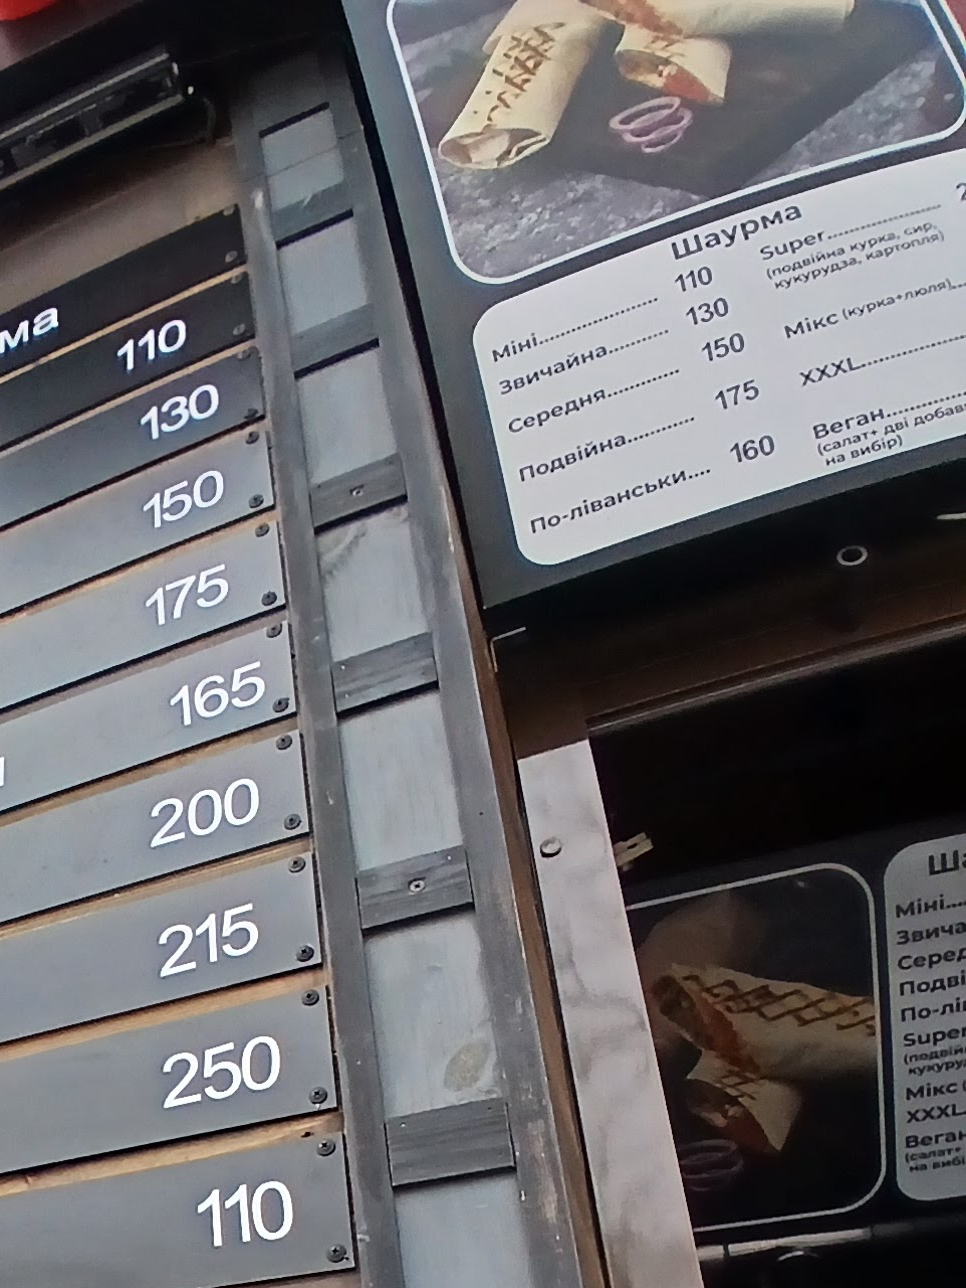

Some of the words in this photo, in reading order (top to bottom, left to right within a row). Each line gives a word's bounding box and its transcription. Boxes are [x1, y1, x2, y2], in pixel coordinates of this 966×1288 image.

[670, 204, 803, 260] Шаурма
[760, 230, 825, 261] Super
[766, 247, 845, 280] (подвійна
[850, 231, 900, 253] курка,
[774, 257, 862, 289] кукурудза,
[866, 230, 945, 261] картопля)
[492, 333, 539, 363] Міні
[674, 266, 713, 293] 110
[784, 313, 839, 339] Мікс
[116, 320, 187, 372] 110
[499, 345, 608, 395] Звичайна
[685, 297, 729, 326] 130
[508, 386, 606, 434] Середня
[701, 332, 746, 362] 150
[139, 384, 220, 441] 130
[519, 430, 628, 482] Подвійна
[714, 380, 761, 411] 175
[812, 408, 885, 440] Веган
[884, 417, 909, 436] дві
[913, 403, 966, 427] добав
[825, 453, 846, 467] на
[850, 434, 903, 459] вибір)
[143, 469, 224, 529] 150
[530, 467, 689, 533] По-ліванськи
[730, 434, 775, 464] 160
[145, 564, 230, 626] 175
[169, 662, 266, 728] 165
[148, 778, 260, 848] 200
[895, 894, 944, 918] Міні
[157, 903, 259, 978] 215
[900, 970, 966, 996] Подві
[901, 997, 966, 1022] По-лі
[162, 1035, 281, 1109] 250
[906, 1082, 957, 1102] Мікс
[196, 1180, 294, 1249] 110
